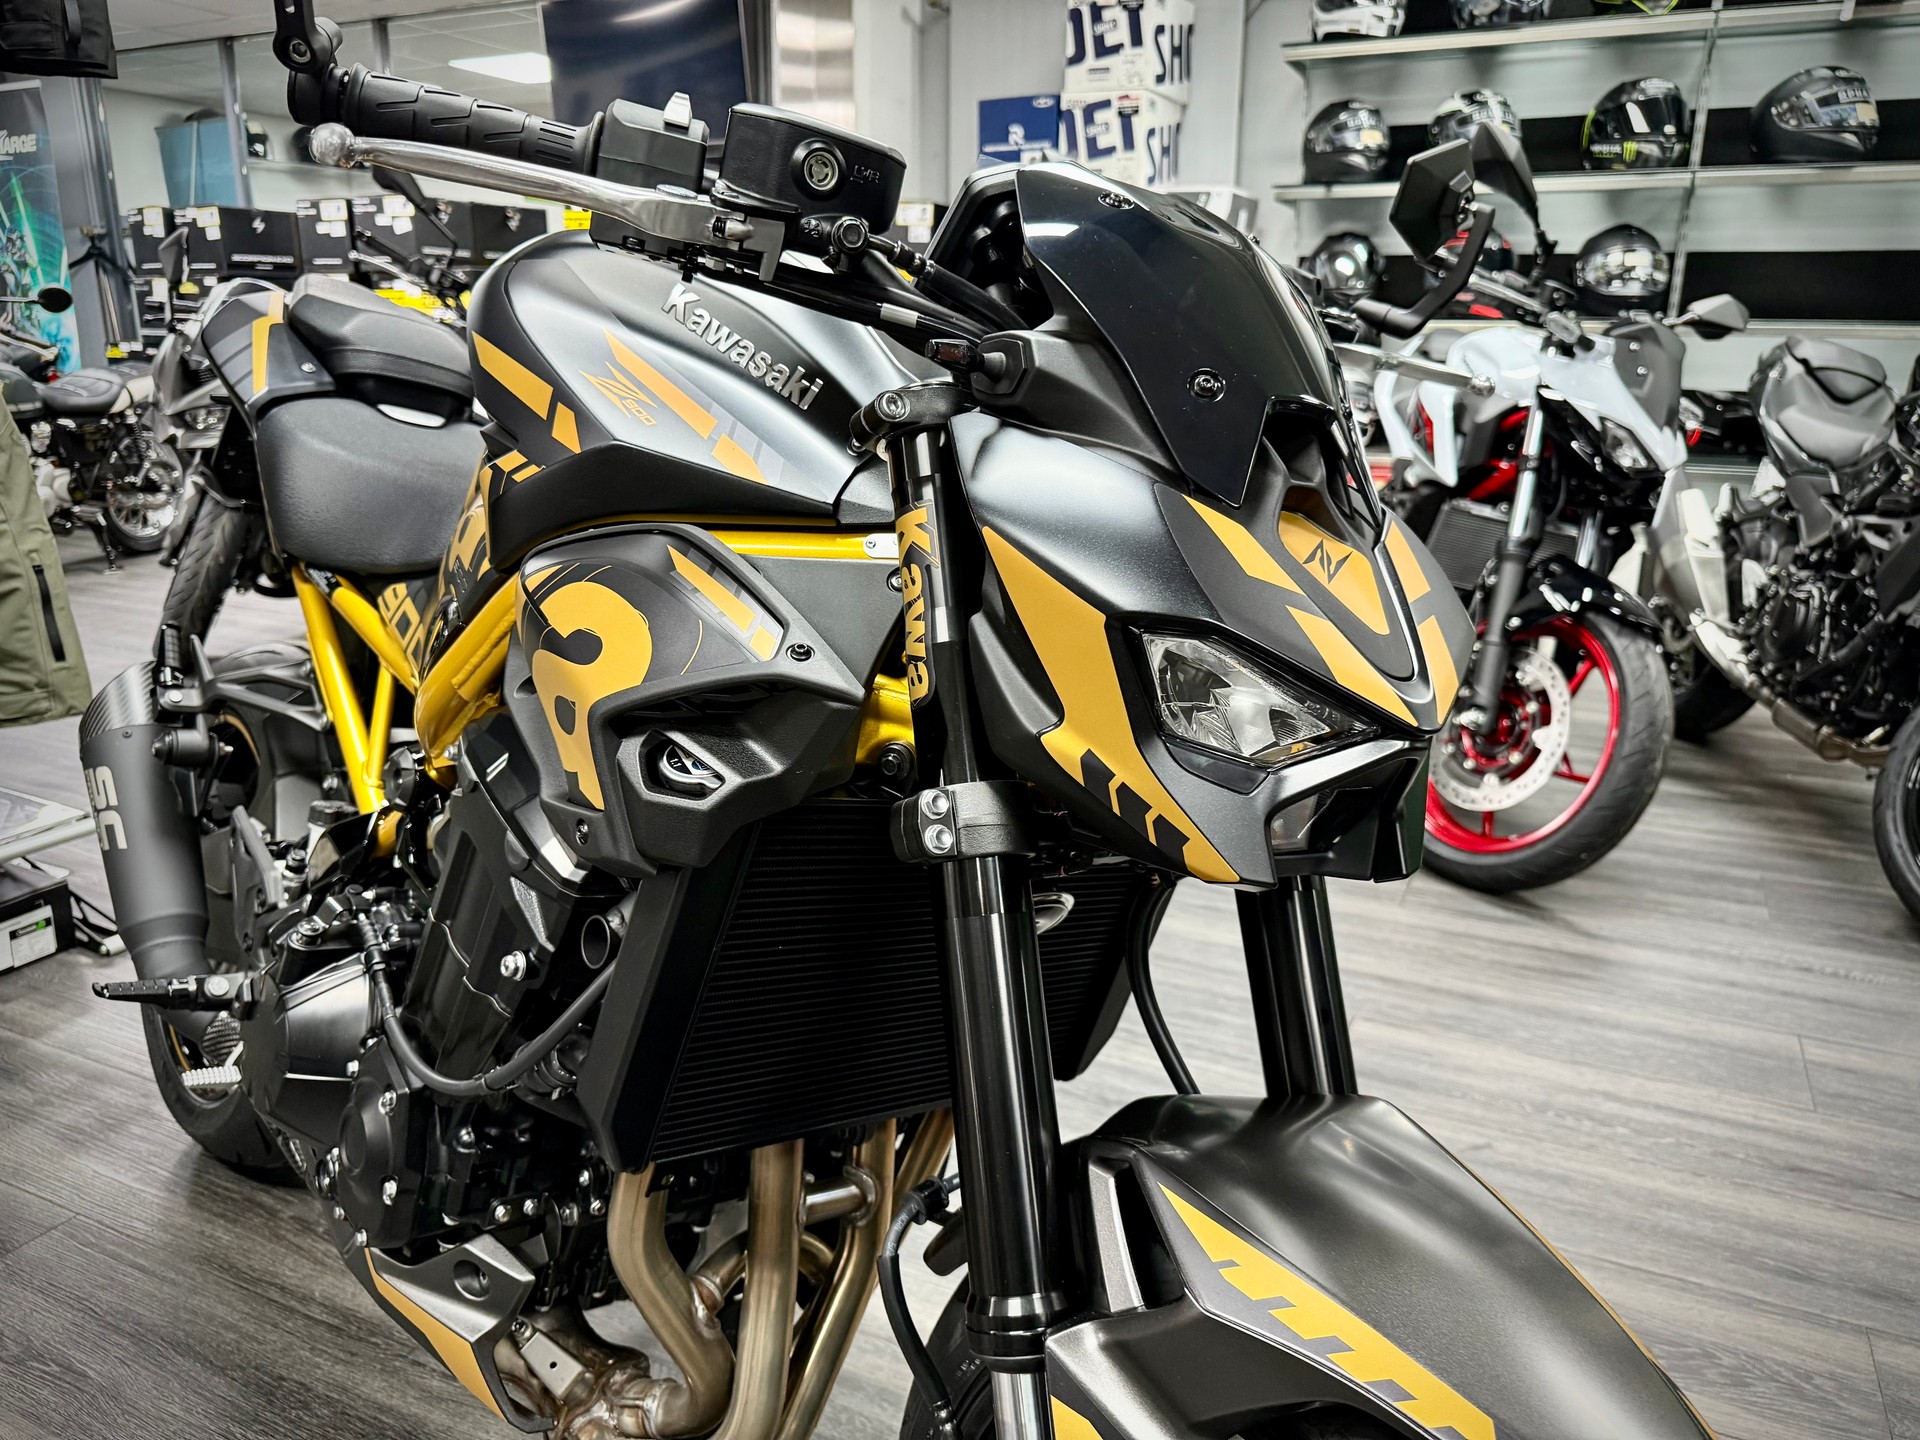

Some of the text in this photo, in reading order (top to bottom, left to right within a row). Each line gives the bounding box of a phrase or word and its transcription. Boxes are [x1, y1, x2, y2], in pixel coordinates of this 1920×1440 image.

[1066, 1, 1143, 66] JET
[0, 132, 37, 154] ARGE
[1061, 98, 1135, 160] JET
[661, 282, 824, 411] Kawasaki
[621, 399, 657, 426] 900
[85, 765, 128, 851] SC
